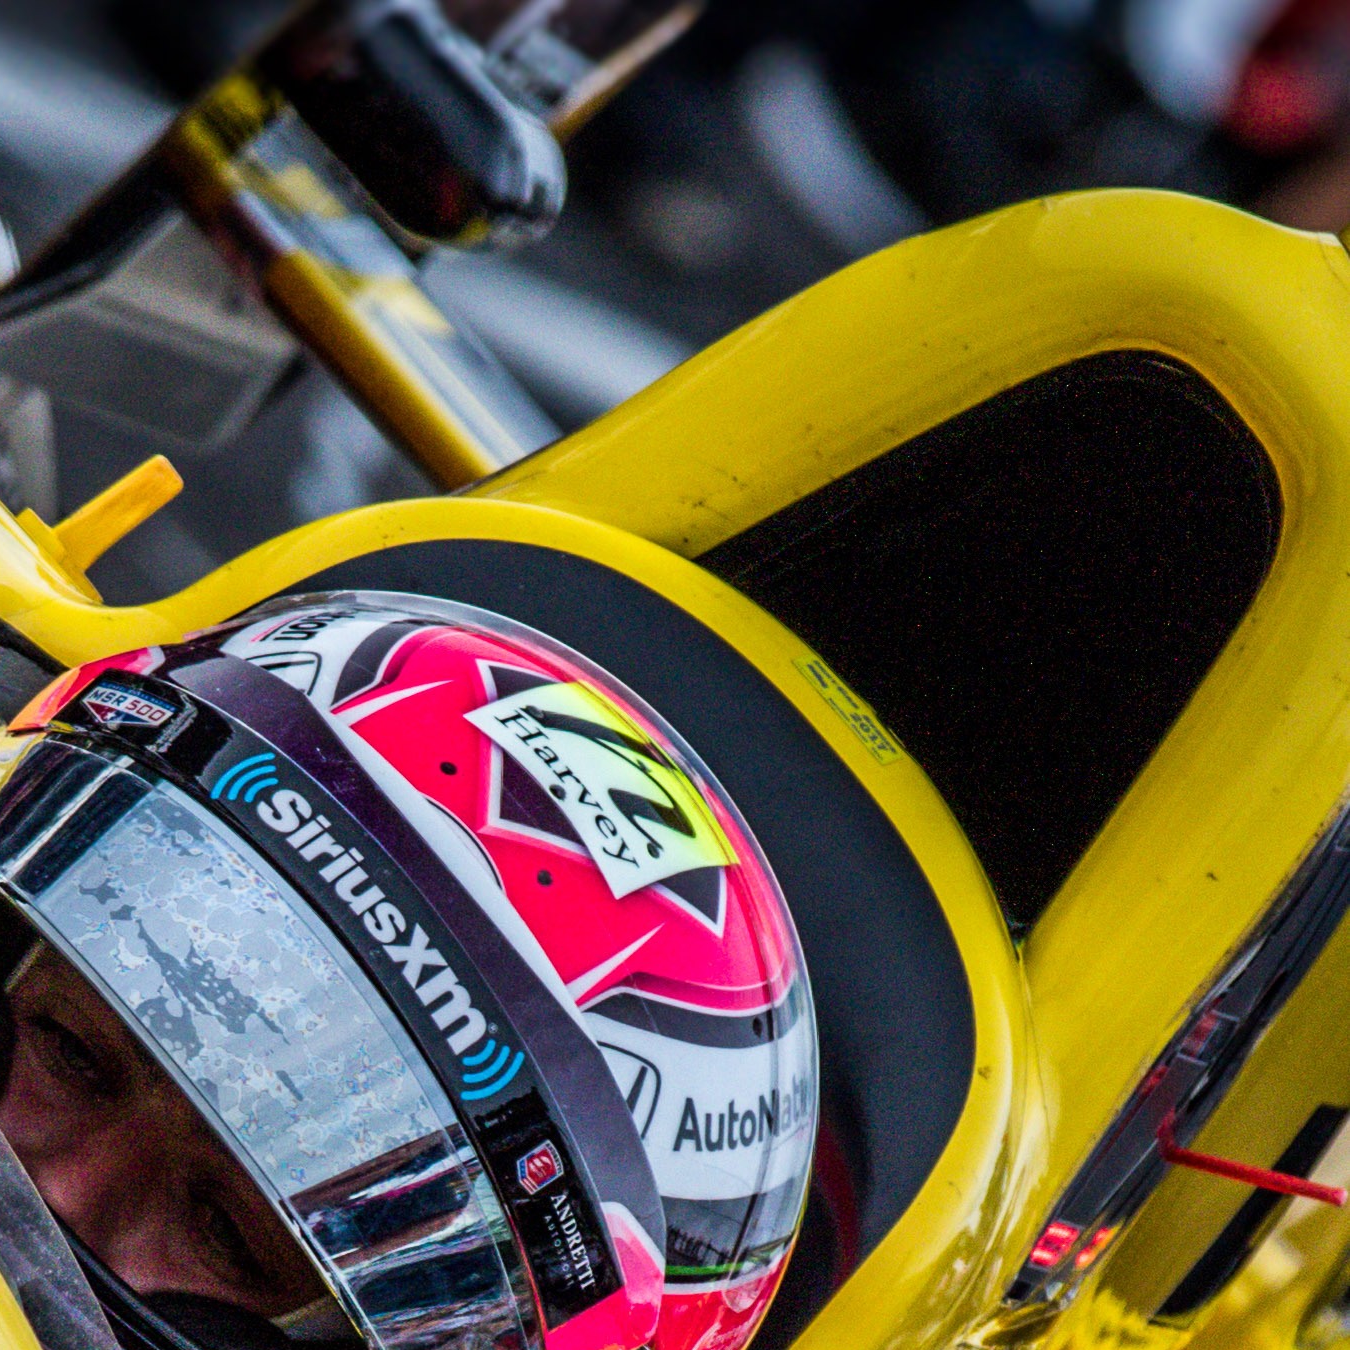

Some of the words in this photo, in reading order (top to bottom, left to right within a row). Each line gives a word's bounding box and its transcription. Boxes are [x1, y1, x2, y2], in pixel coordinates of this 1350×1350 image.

[89, 688, 129, 708] MSR
[125, 699, 166, 722] 500
[493, 709, 641, 869] Harvey
[550, 1193, 596, 1291] ANDRETTI
